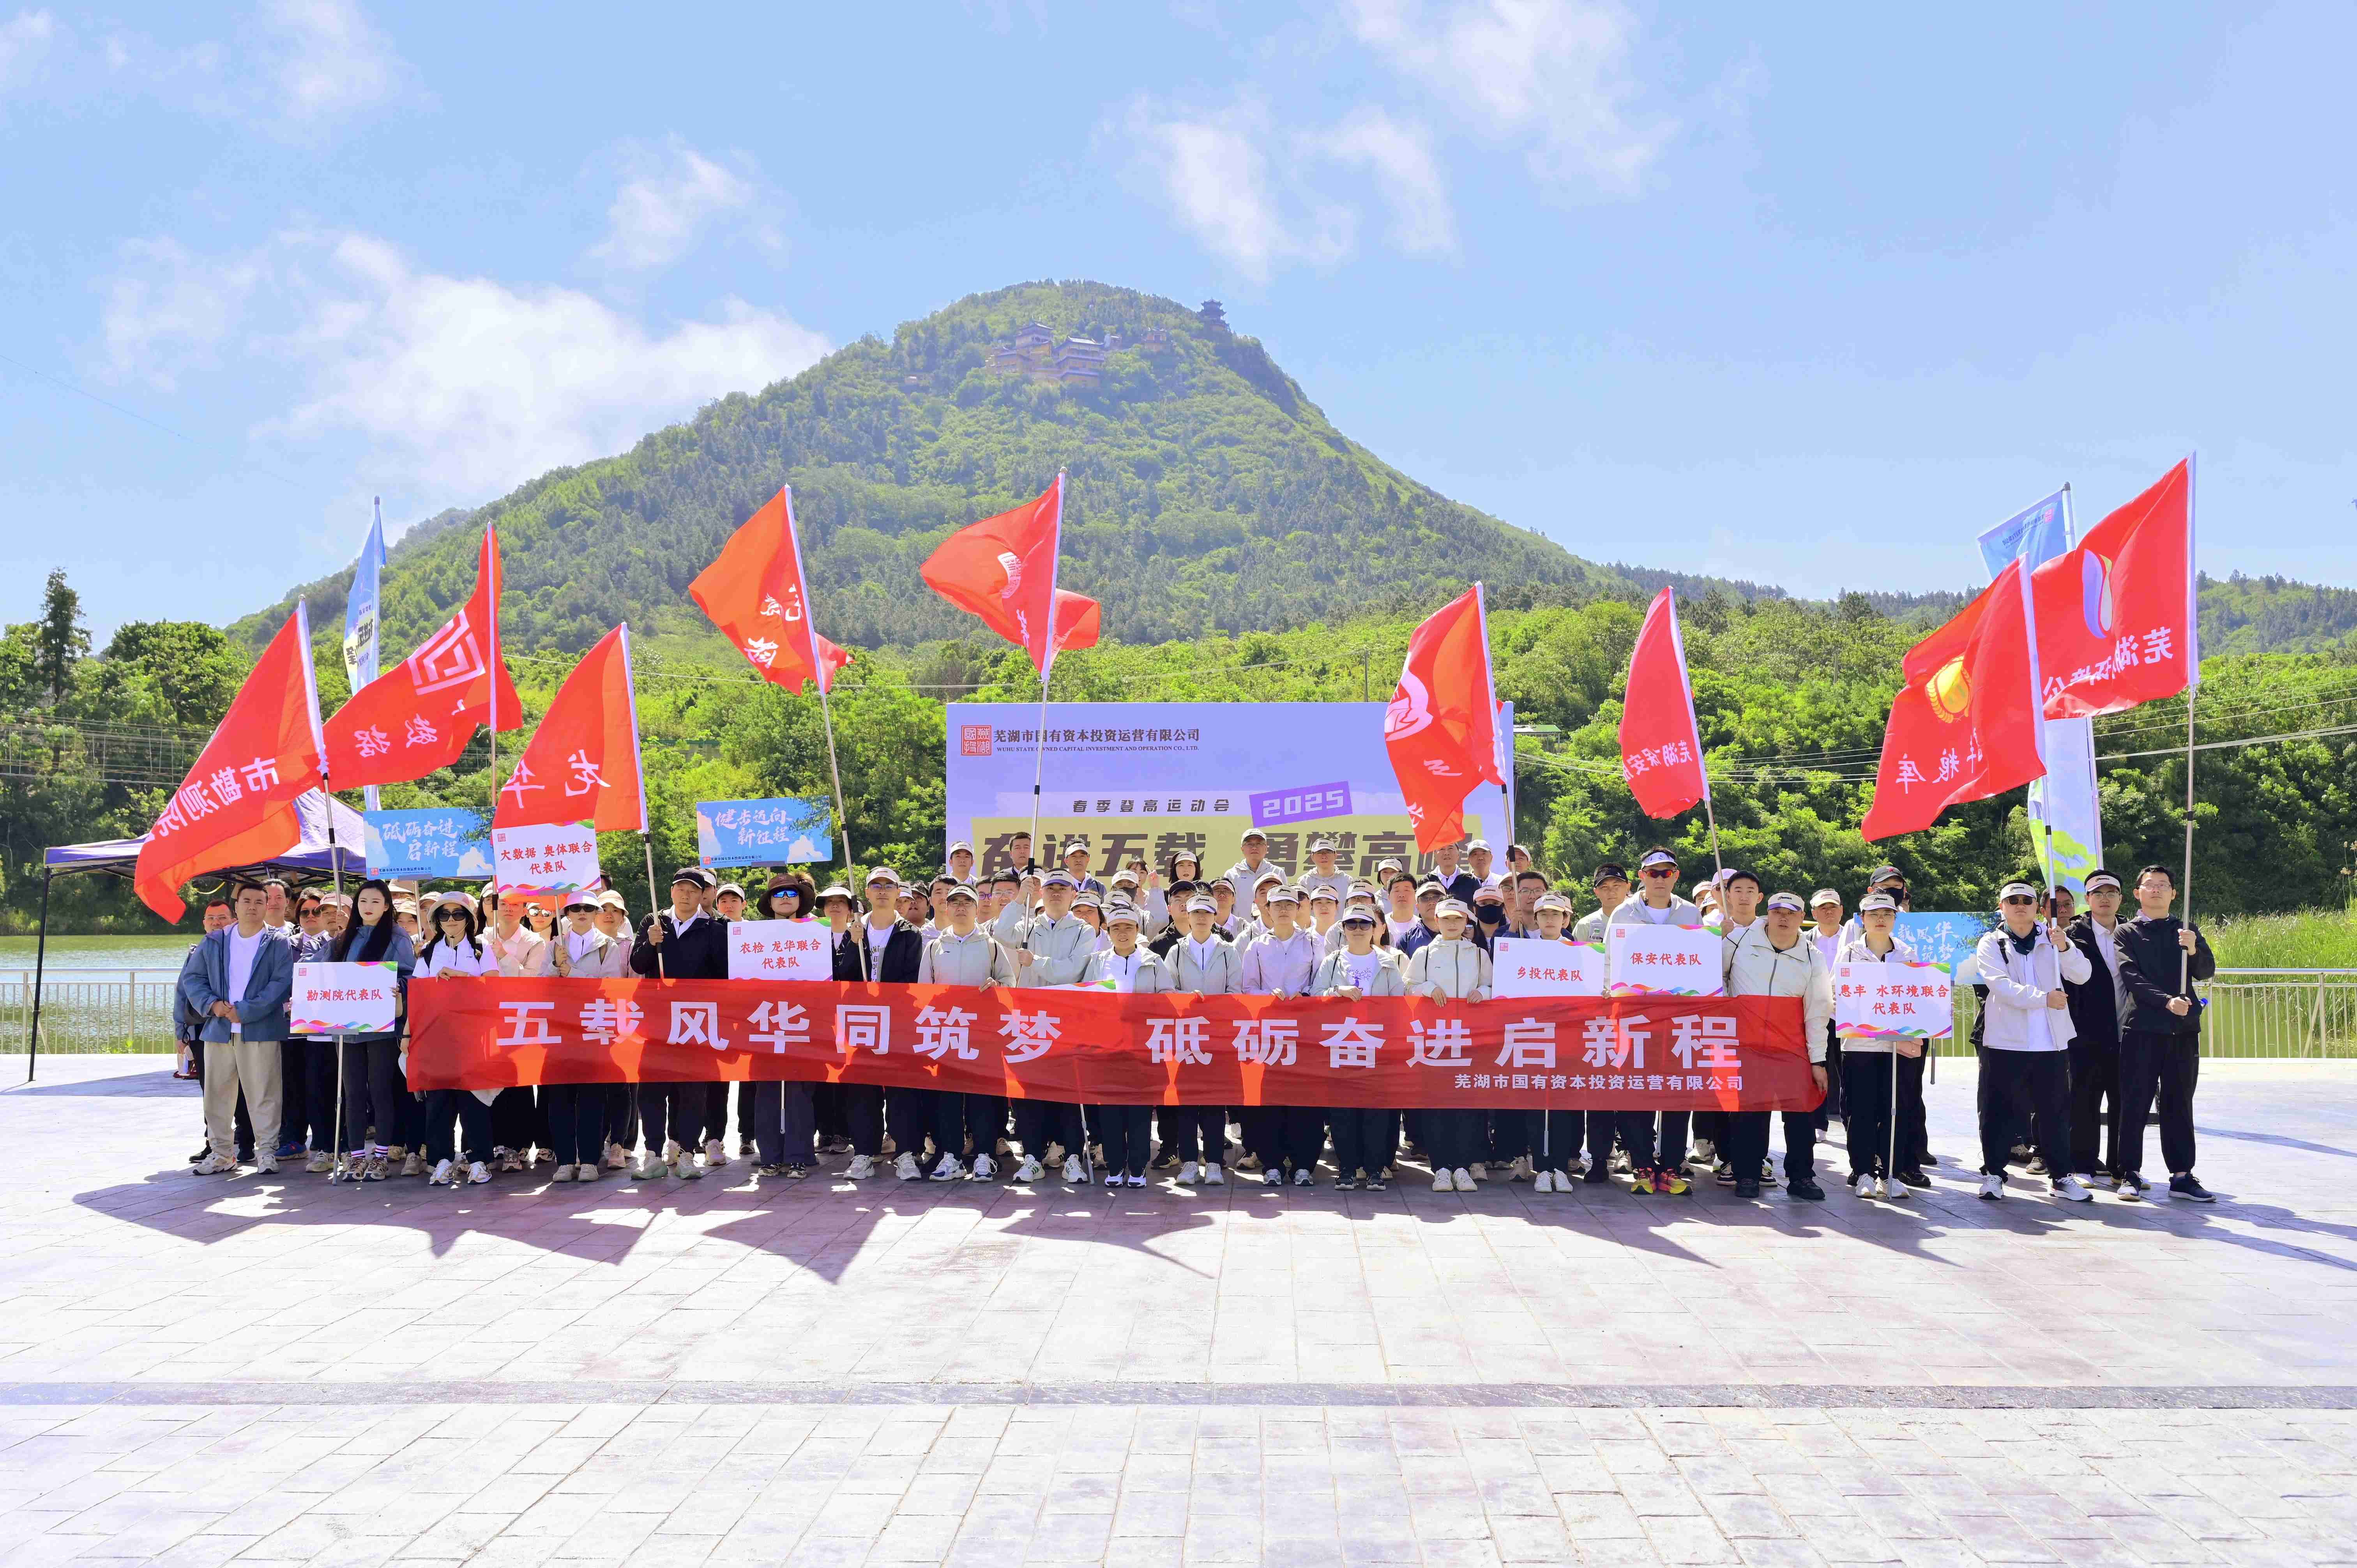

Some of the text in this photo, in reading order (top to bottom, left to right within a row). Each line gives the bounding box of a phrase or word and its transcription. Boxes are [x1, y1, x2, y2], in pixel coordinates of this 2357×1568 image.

[994, 729, 1199, 743] 芜湖市国有资本投资运营有限公司
[1072, 799, 1230, 812] 春季登高运动会
[1263, 789, 1344, 818] 2025
[382, 818, 464, 843] 砥砺奋进
[737, 826, 790, 848] 新征程
[406, 839, 459, 861] 启新程
[500, 841, 593, 861] 大数据 奥体联合
[529, 860, 567, 875] 代表队
[1897, 921, 1959, 944] 载风华
[739, 939, 822, 954] 农检 龙华联合
[762, 956, 800, 969] 代表队
[1630, 952, 1702, 966] 保安代表队
[1517, 966, 1583, 982] 乡投代表队
[306, 988, 383, 1001] 勘测院代表队
[1838, 984, 1950, 998] 惠丰 水环境联合
[1872, 1002, 1916, 1015] 代表队
[496, 998, 1742, 1069] 五载风华同筑梦 砥砺奋进启新程
[1454, 1074, 1742, 1091] 芜湖市国有资本投资运营有限公司
